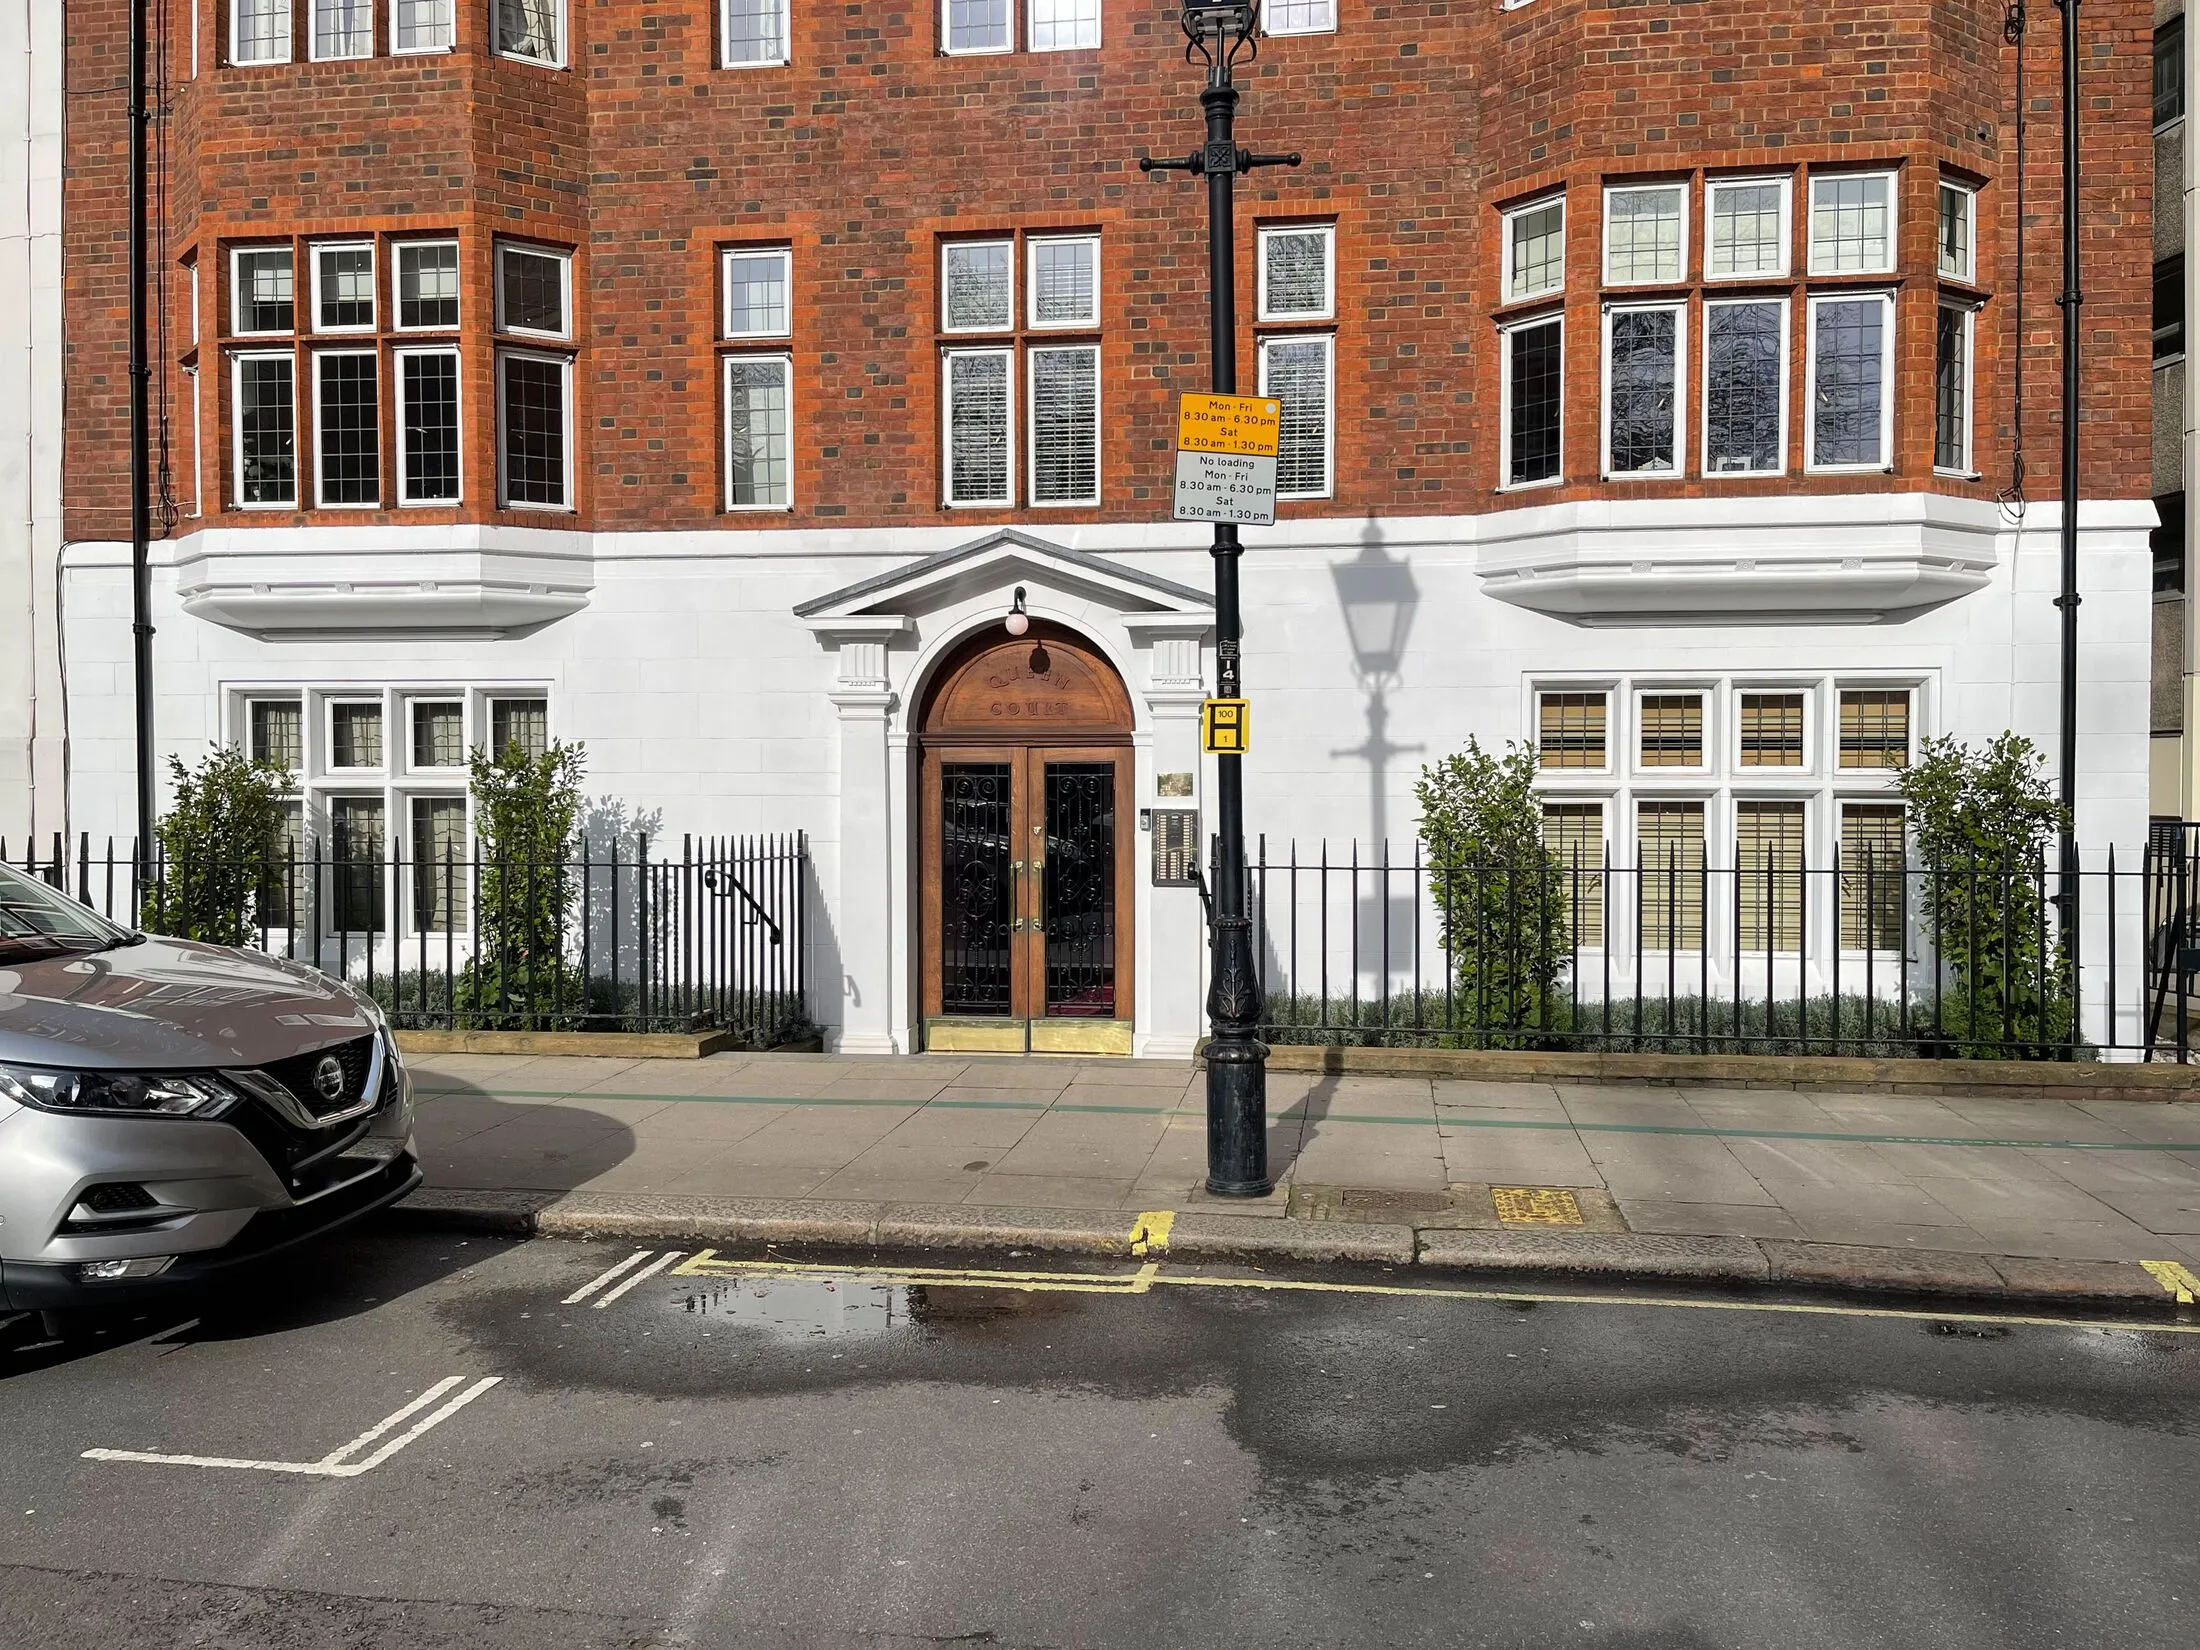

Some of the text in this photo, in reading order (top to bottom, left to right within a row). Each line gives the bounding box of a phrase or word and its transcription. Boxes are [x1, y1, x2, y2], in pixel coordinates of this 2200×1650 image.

[1209, 401, 1231, 411] Mon
[1239, 403, 1253, 412] Fri
[1184, 411, 1209, 421] 8.30
[1211, 414, 1226, 423] am
[1234, 415, 1258, 424] 6.30
[1260, 418, 1276, 427] pm
[1220, 427, 1238, 436] Sat
[1184, 437, 1208, 447] 8.30
[1210, 440, 1225, 448] am
[1233, 440, 1256, 450] 1.30
[1258, 444, 1273, 452] pm
[1200, 456, 1255, 470] No loading
[1204, 470, 1227, 480] Mon
[1234, 472, 1249, 481] Fri
[1180, 480, 1205, 490] 8.30
[1206, 484, 1221, 492] am
[1229, 484, 1254, 494] 6.30
[1256, 487, 1272, 496] pm
[1215, 496, 1234, 506] Sat
[1179, 506, 1204, 516] 8.30
[1206, 509, 1221, 517] am
[1229, 509, 1252, 519] 1.30
[1253, 512, 1269, 521] pm
[990, 702, 1068, 716] COURT
[1218, 710, 1234, 718] 100
[1223, 735, 1228, 743] 1
